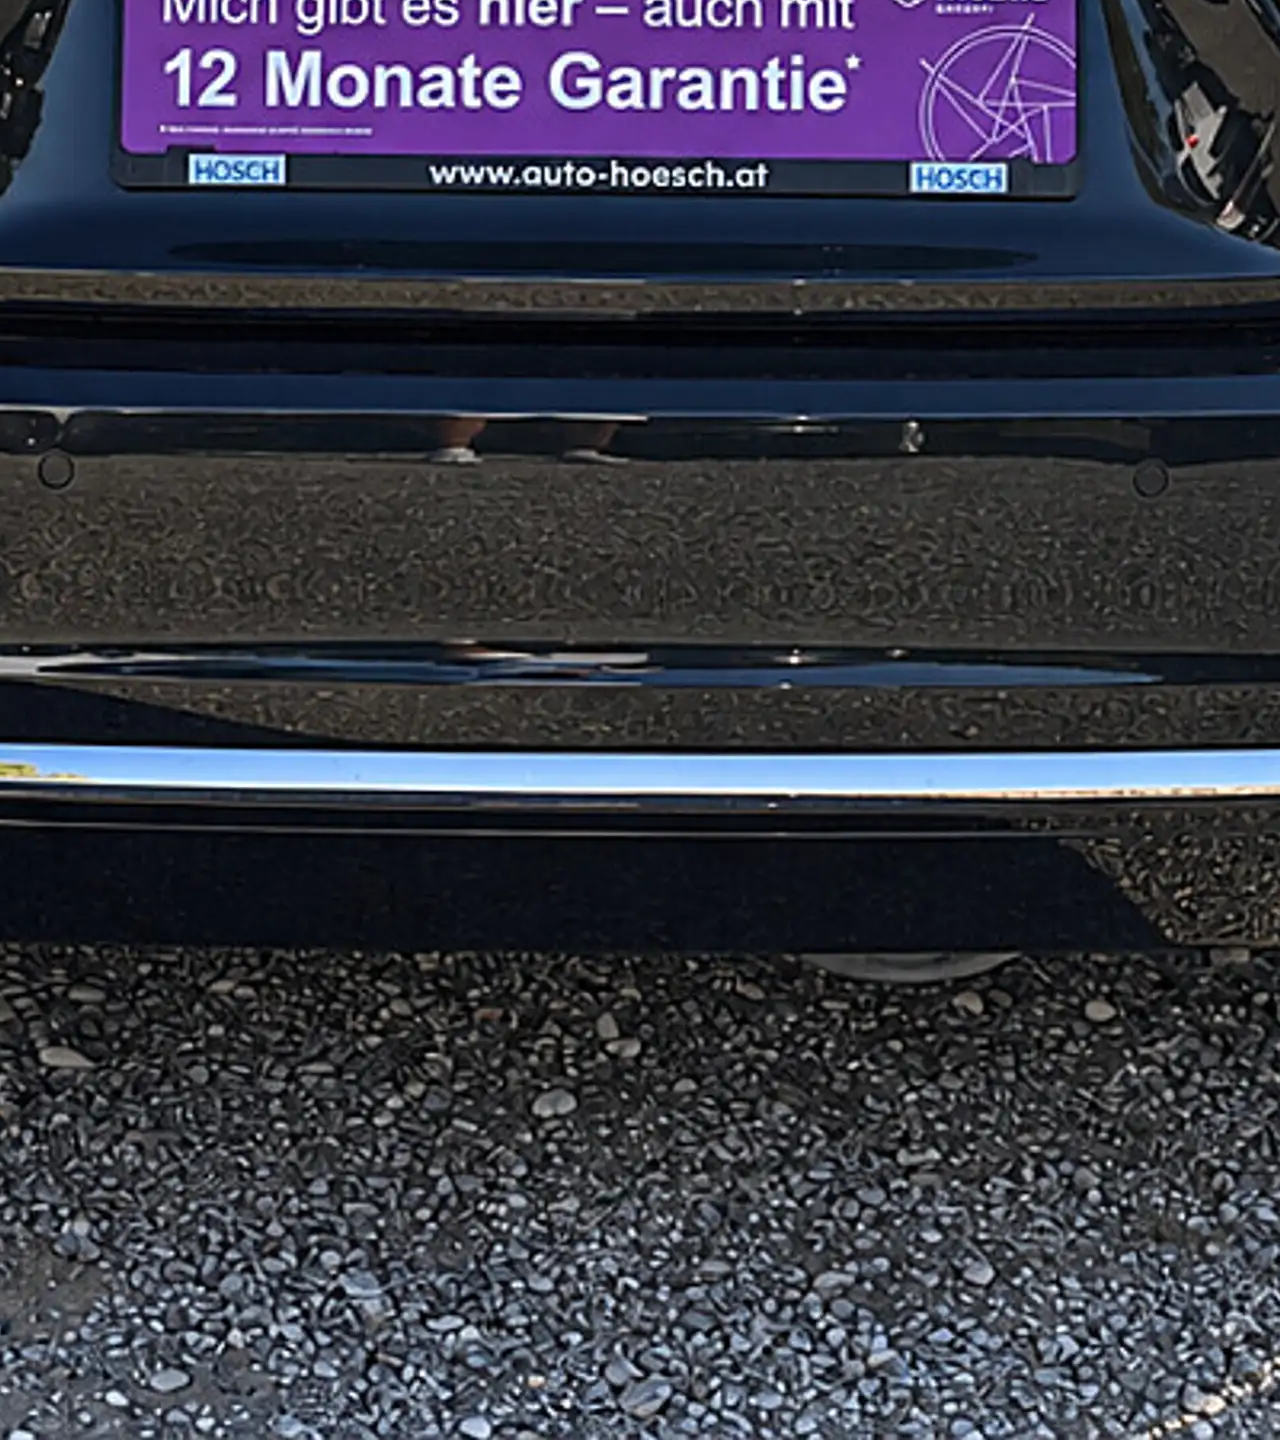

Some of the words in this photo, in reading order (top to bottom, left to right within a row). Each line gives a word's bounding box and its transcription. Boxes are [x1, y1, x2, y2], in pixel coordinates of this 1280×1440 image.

[163, 48, 238, 108] 12
[264, 50, 522, 110] Monate
[428, 160, 770, 188] www.auto-hoesch.at
